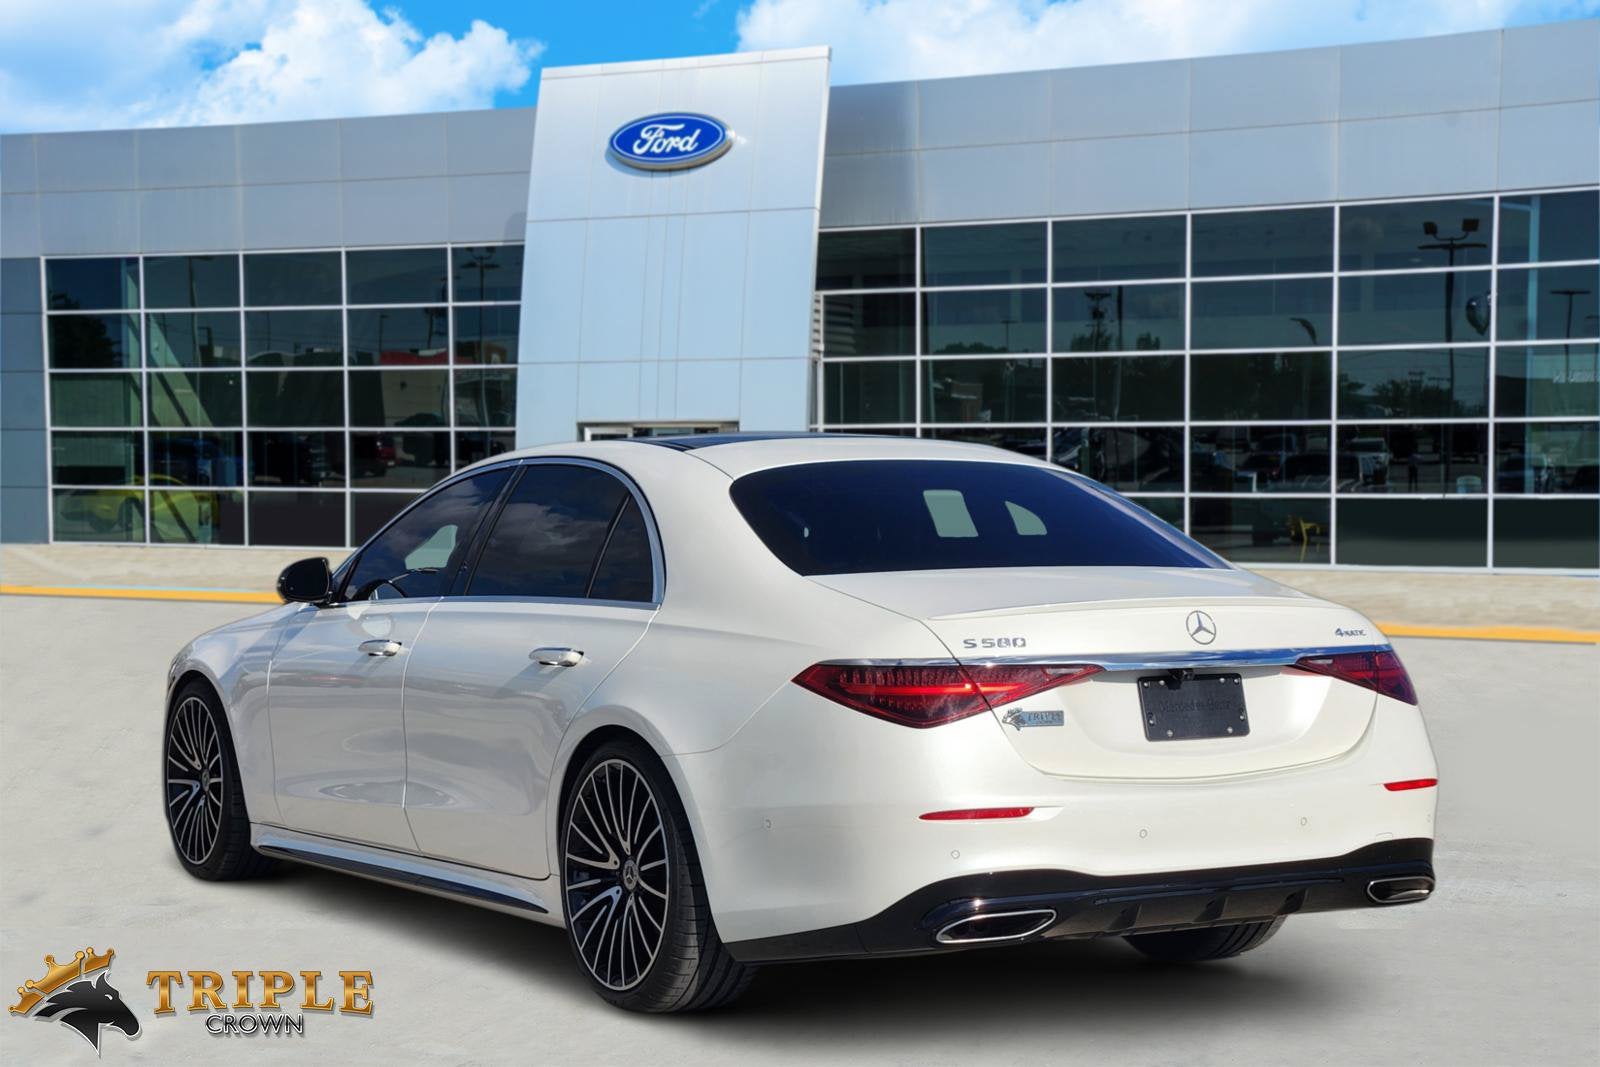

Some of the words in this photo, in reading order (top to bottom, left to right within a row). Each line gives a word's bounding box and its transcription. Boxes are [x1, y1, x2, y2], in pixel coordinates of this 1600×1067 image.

[633, 123, 702, 154] Ford
[963, 638, 978, 649] S
[981, 637, 1027, 648] 580
